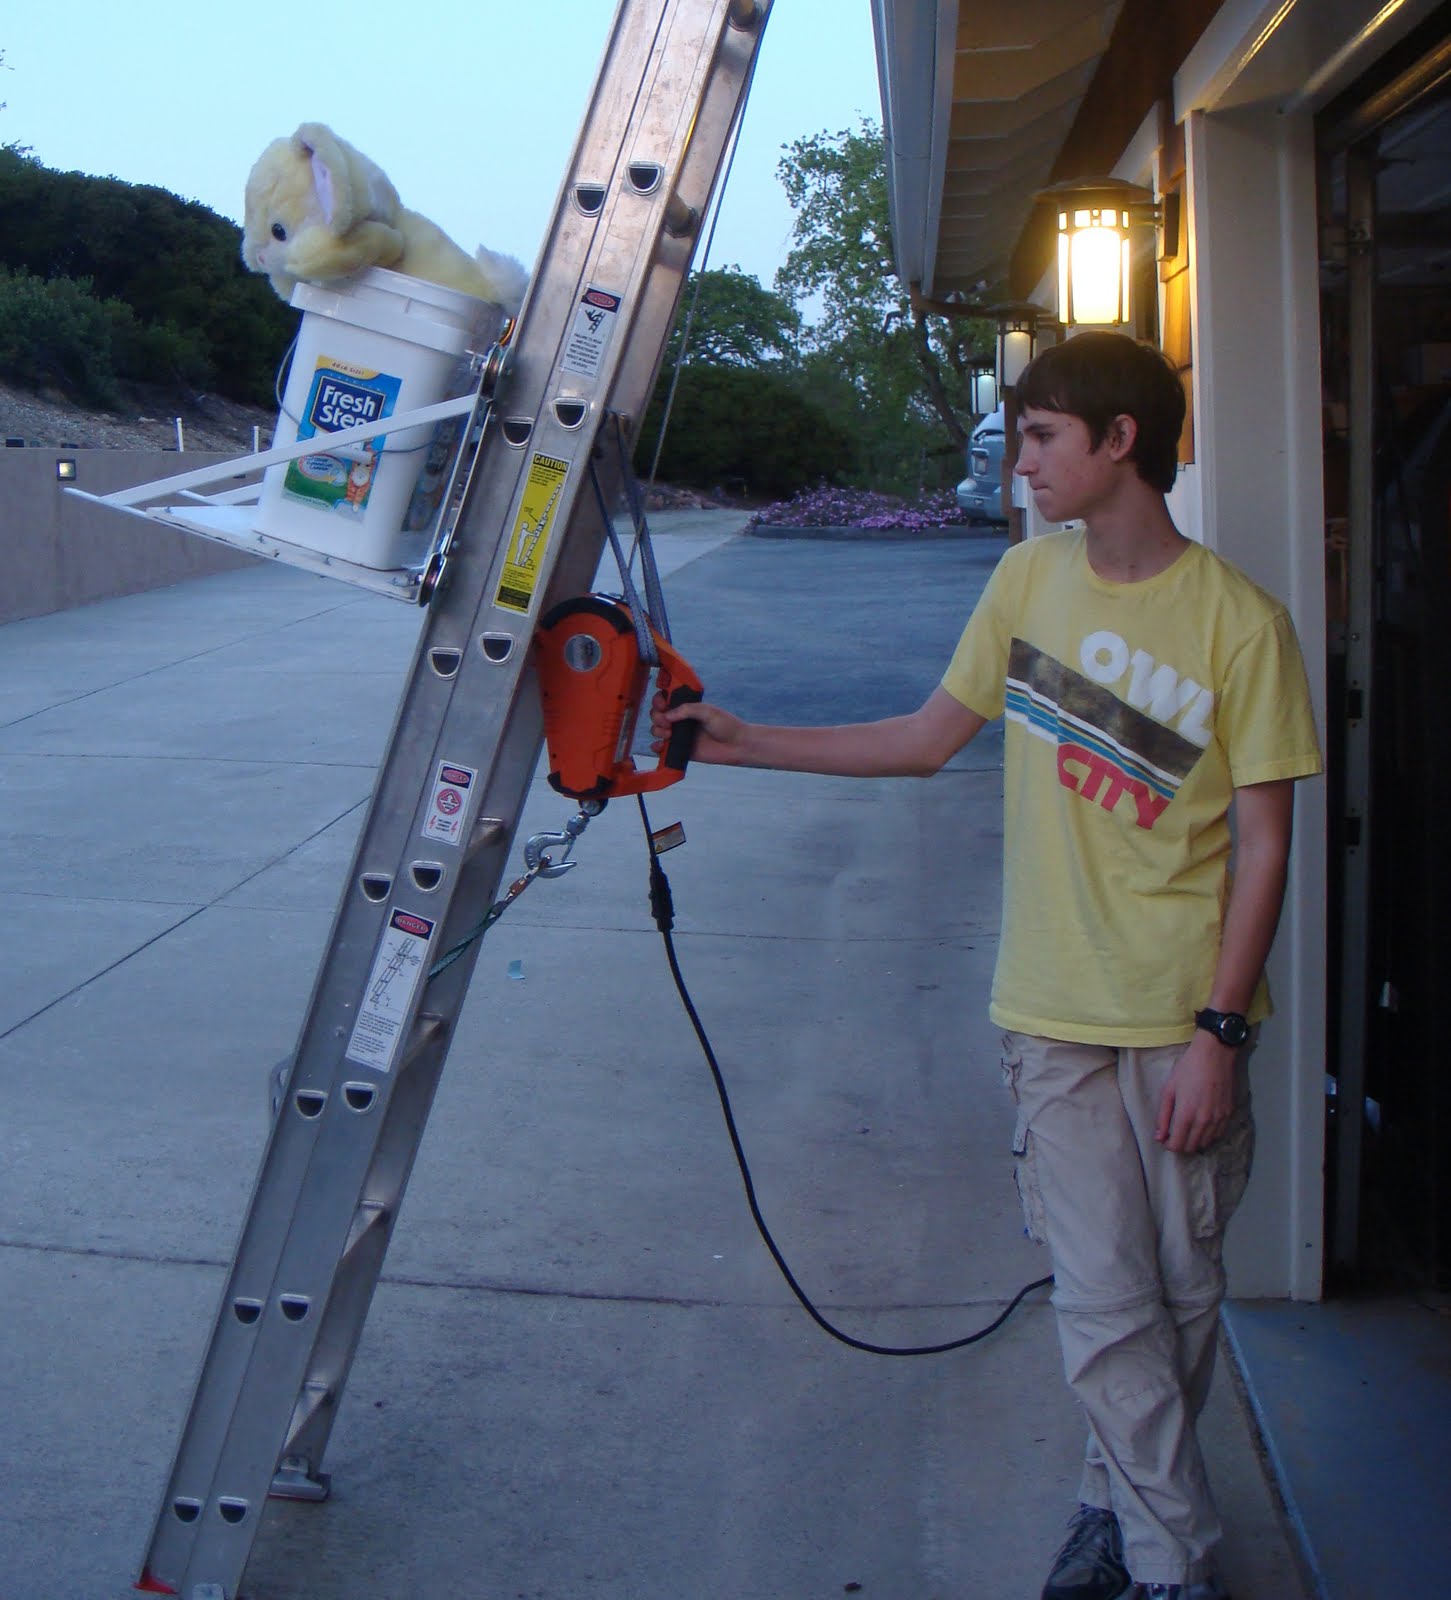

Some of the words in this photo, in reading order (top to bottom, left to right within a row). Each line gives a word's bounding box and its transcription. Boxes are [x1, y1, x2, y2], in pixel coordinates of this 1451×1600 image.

[322, 385, 376, 417] Fresh
[534, 454, 568, 471] CAUTION
[1080, 631, 1215, 747] OWL
[1057, 743, 1171, 830] CITY
